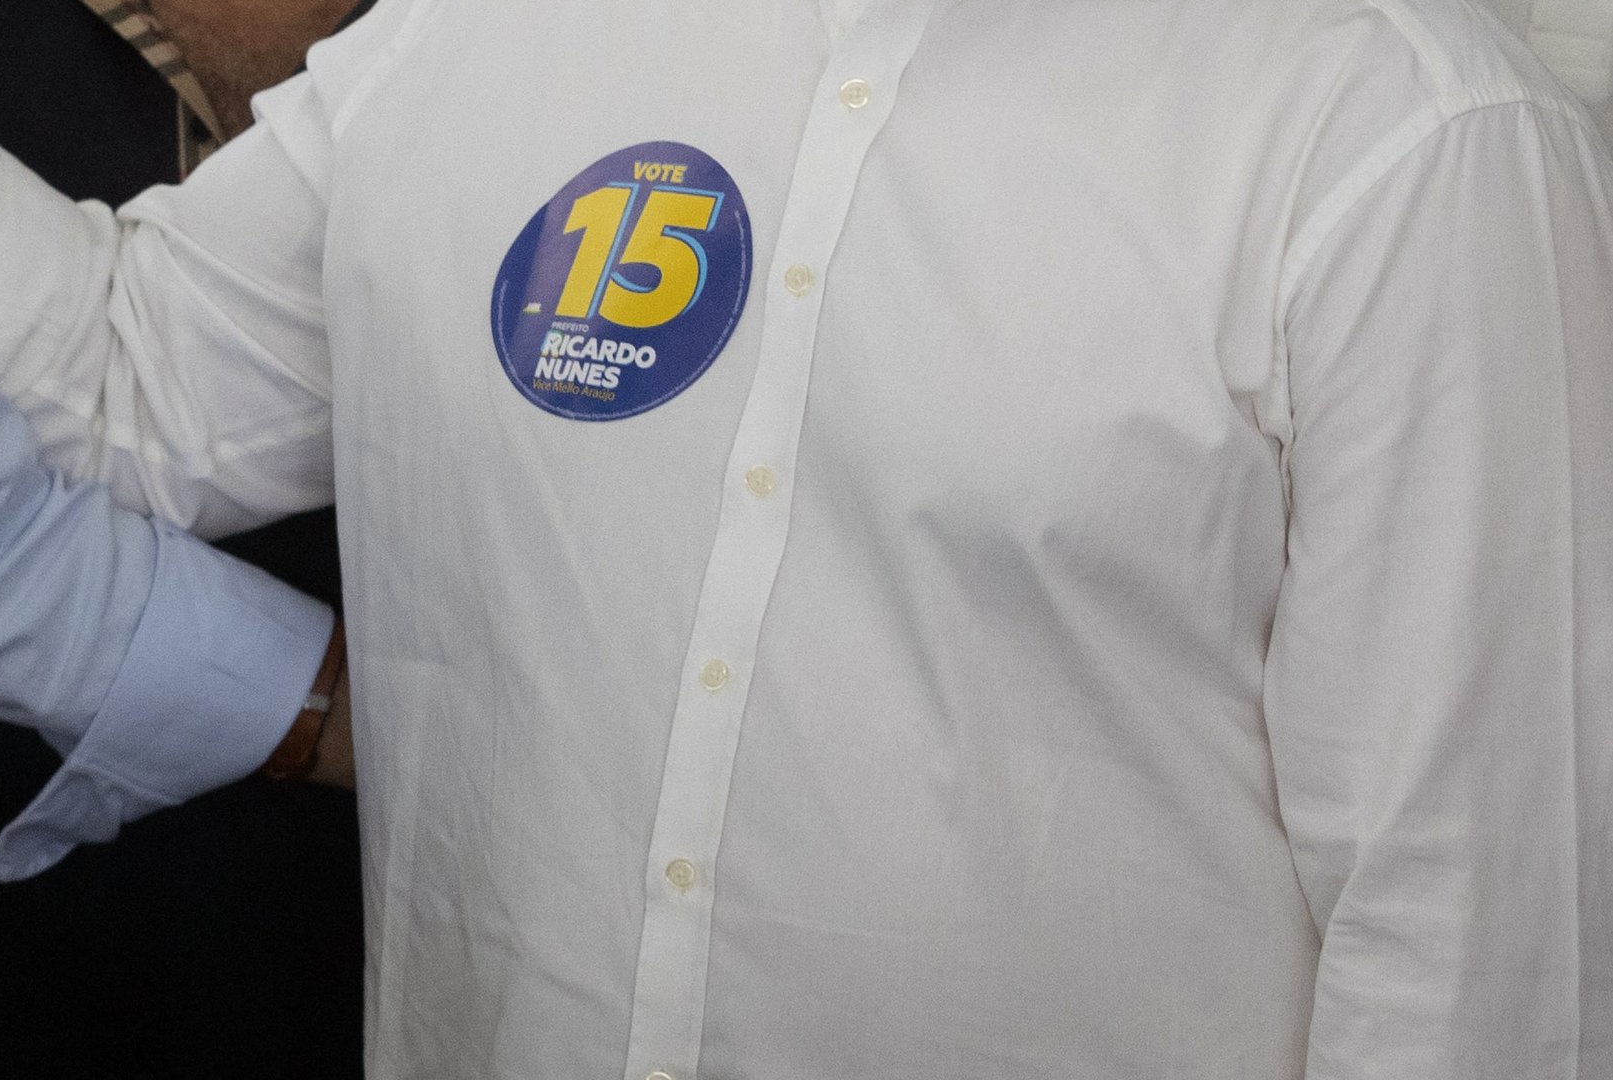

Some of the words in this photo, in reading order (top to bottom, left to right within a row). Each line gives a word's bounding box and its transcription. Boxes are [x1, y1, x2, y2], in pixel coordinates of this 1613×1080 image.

[633, 161, 688, 183] VOTE
[554, 182, 724, 328] 15
[551, 321, 589, 333] PREFEITO
[542, 330, 656, 368] RICARDO
[535, 356, 621, 387] NUNES
